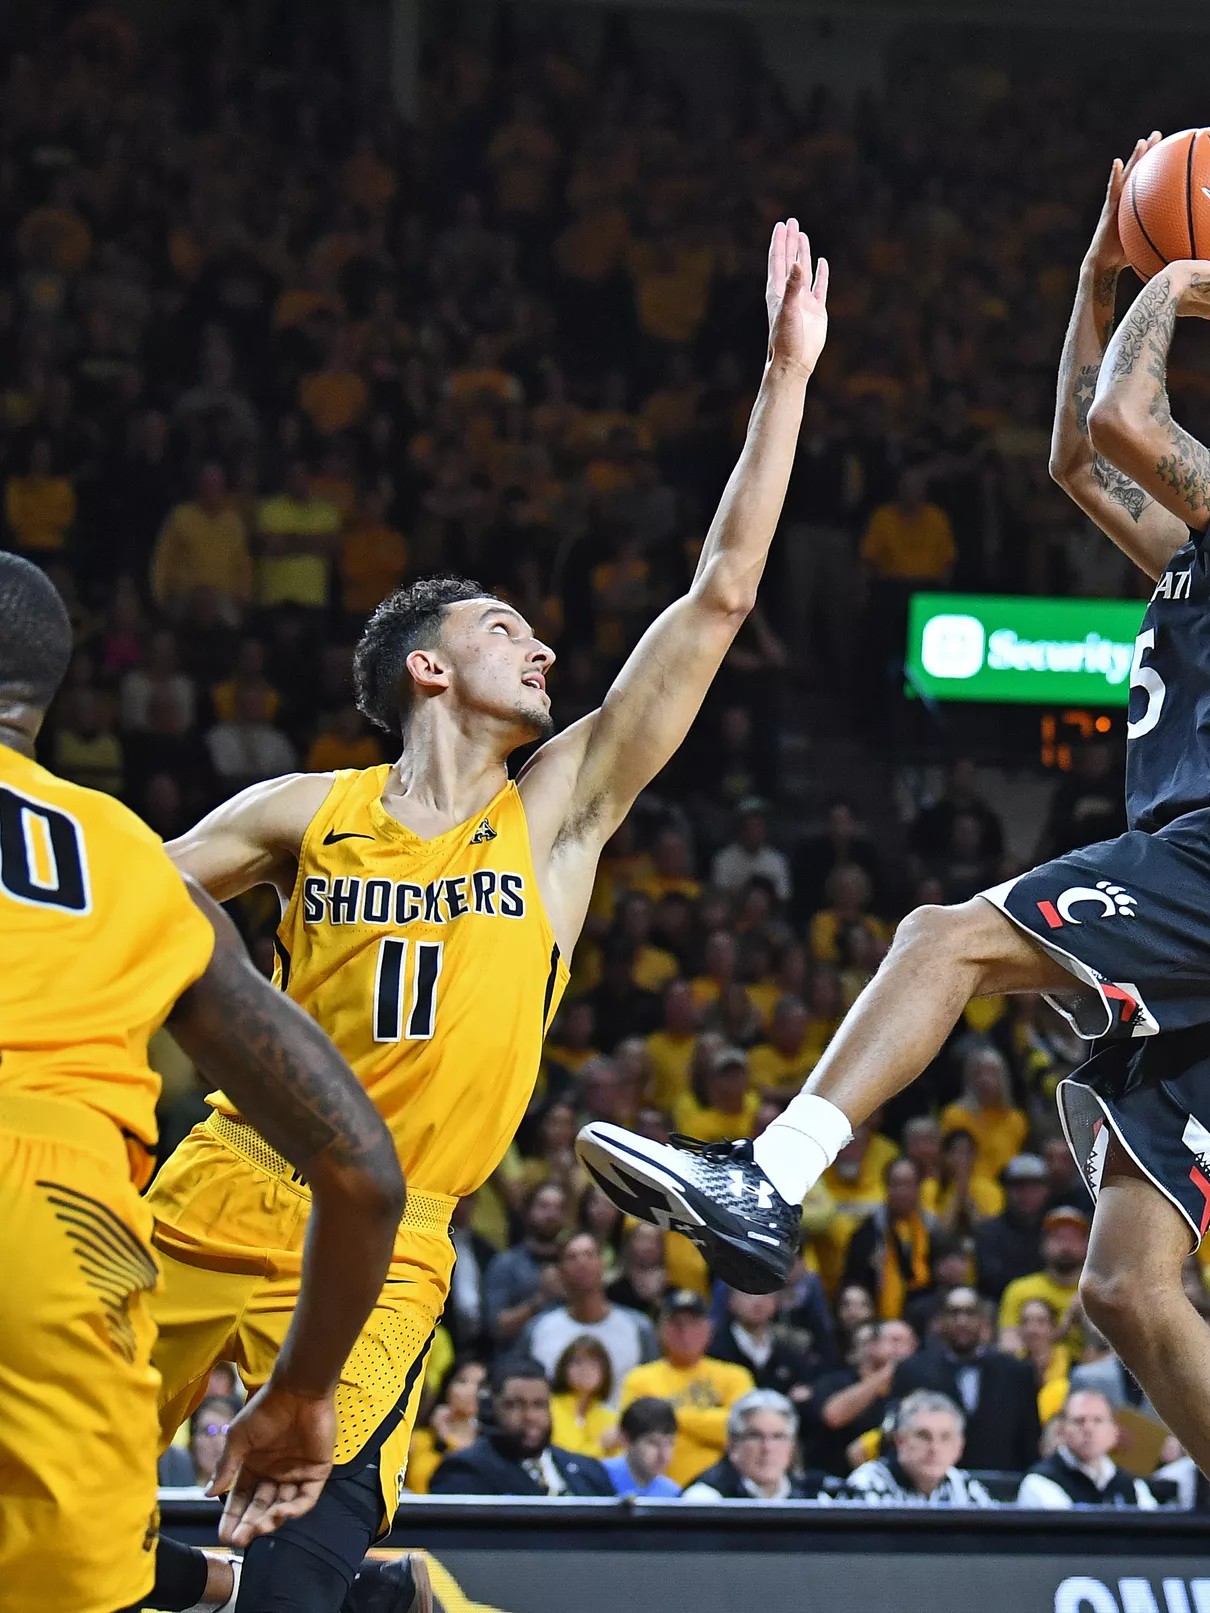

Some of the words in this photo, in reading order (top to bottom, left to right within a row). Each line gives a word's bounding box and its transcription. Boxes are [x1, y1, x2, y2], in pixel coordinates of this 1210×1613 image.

[987, 628, 1135, 684] Security
[0, 778, 93, 917] 0
[303, 869, 526, 926] SHOCKERS
[373, 936, 444, 1043] 11
